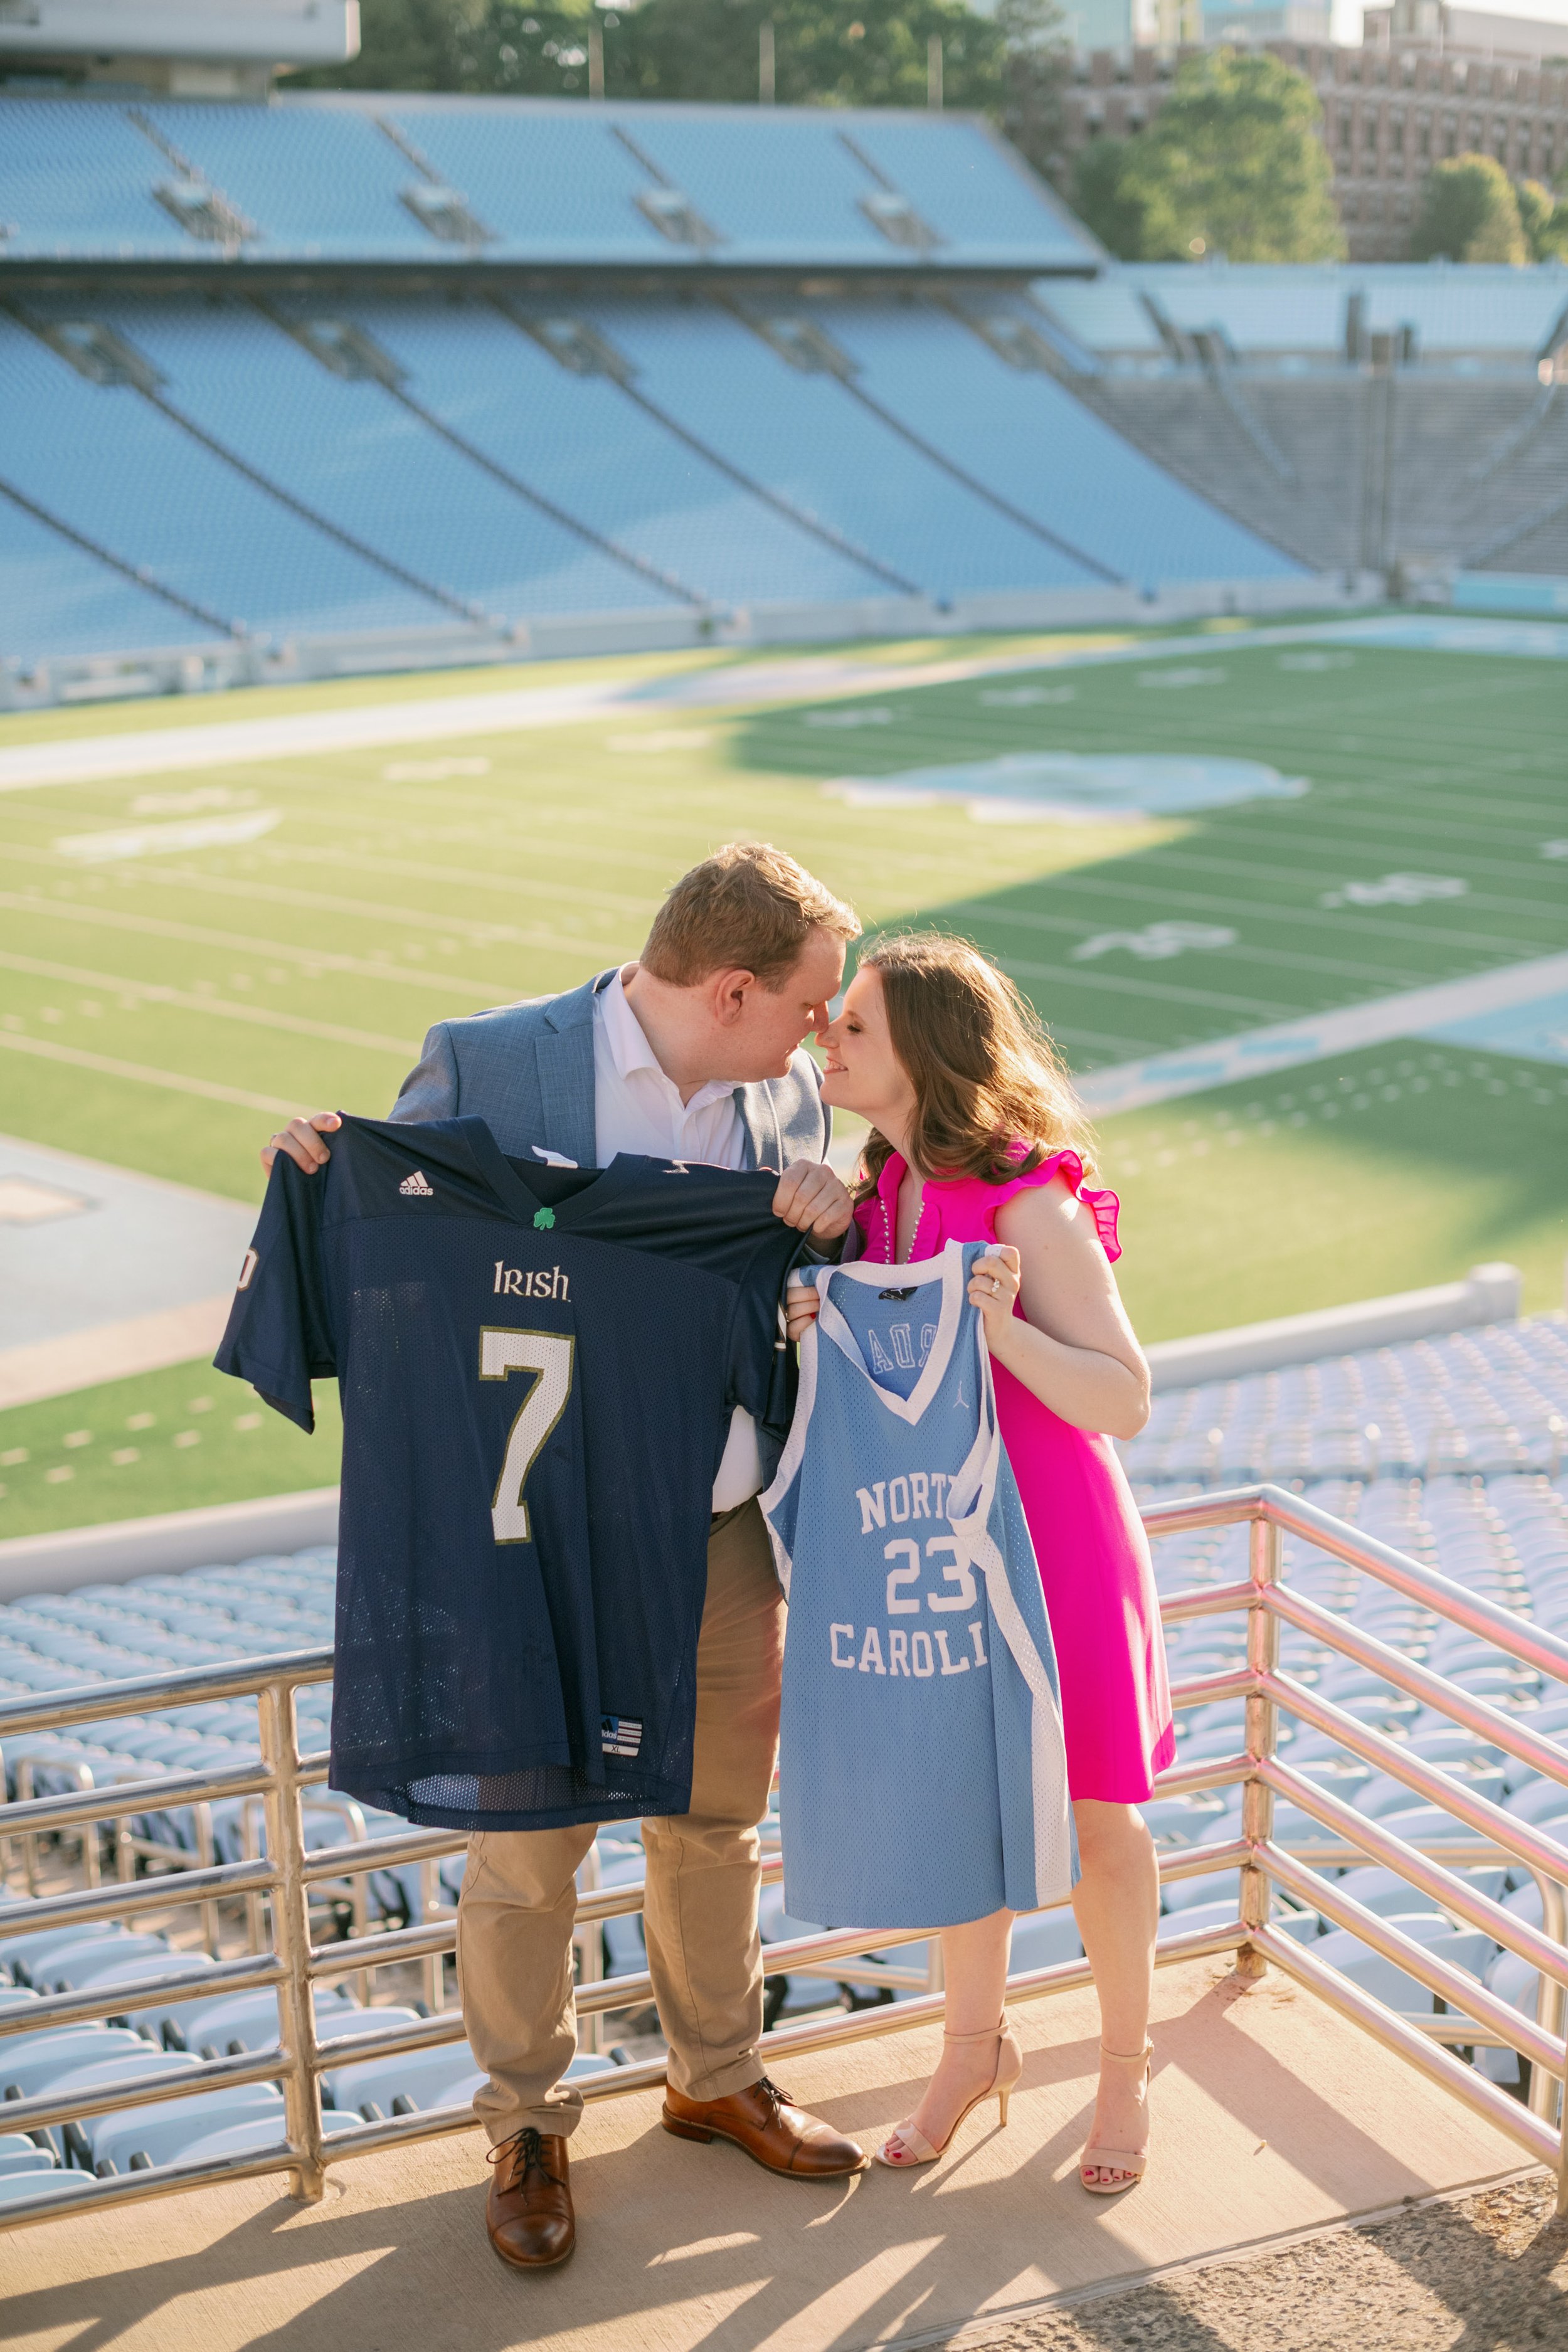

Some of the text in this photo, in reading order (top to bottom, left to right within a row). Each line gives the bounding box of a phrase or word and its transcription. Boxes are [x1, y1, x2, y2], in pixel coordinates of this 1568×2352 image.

[399, 1185, 434, 1196] adidas
[479, 1325, 576, 1546] 7
[856, 1471, 958, 1535] NORT
[884, 1535, 978, 1615] 23
[601, 1729, 618, 1740] idas
[611, 1745, 621, 1754] XL
